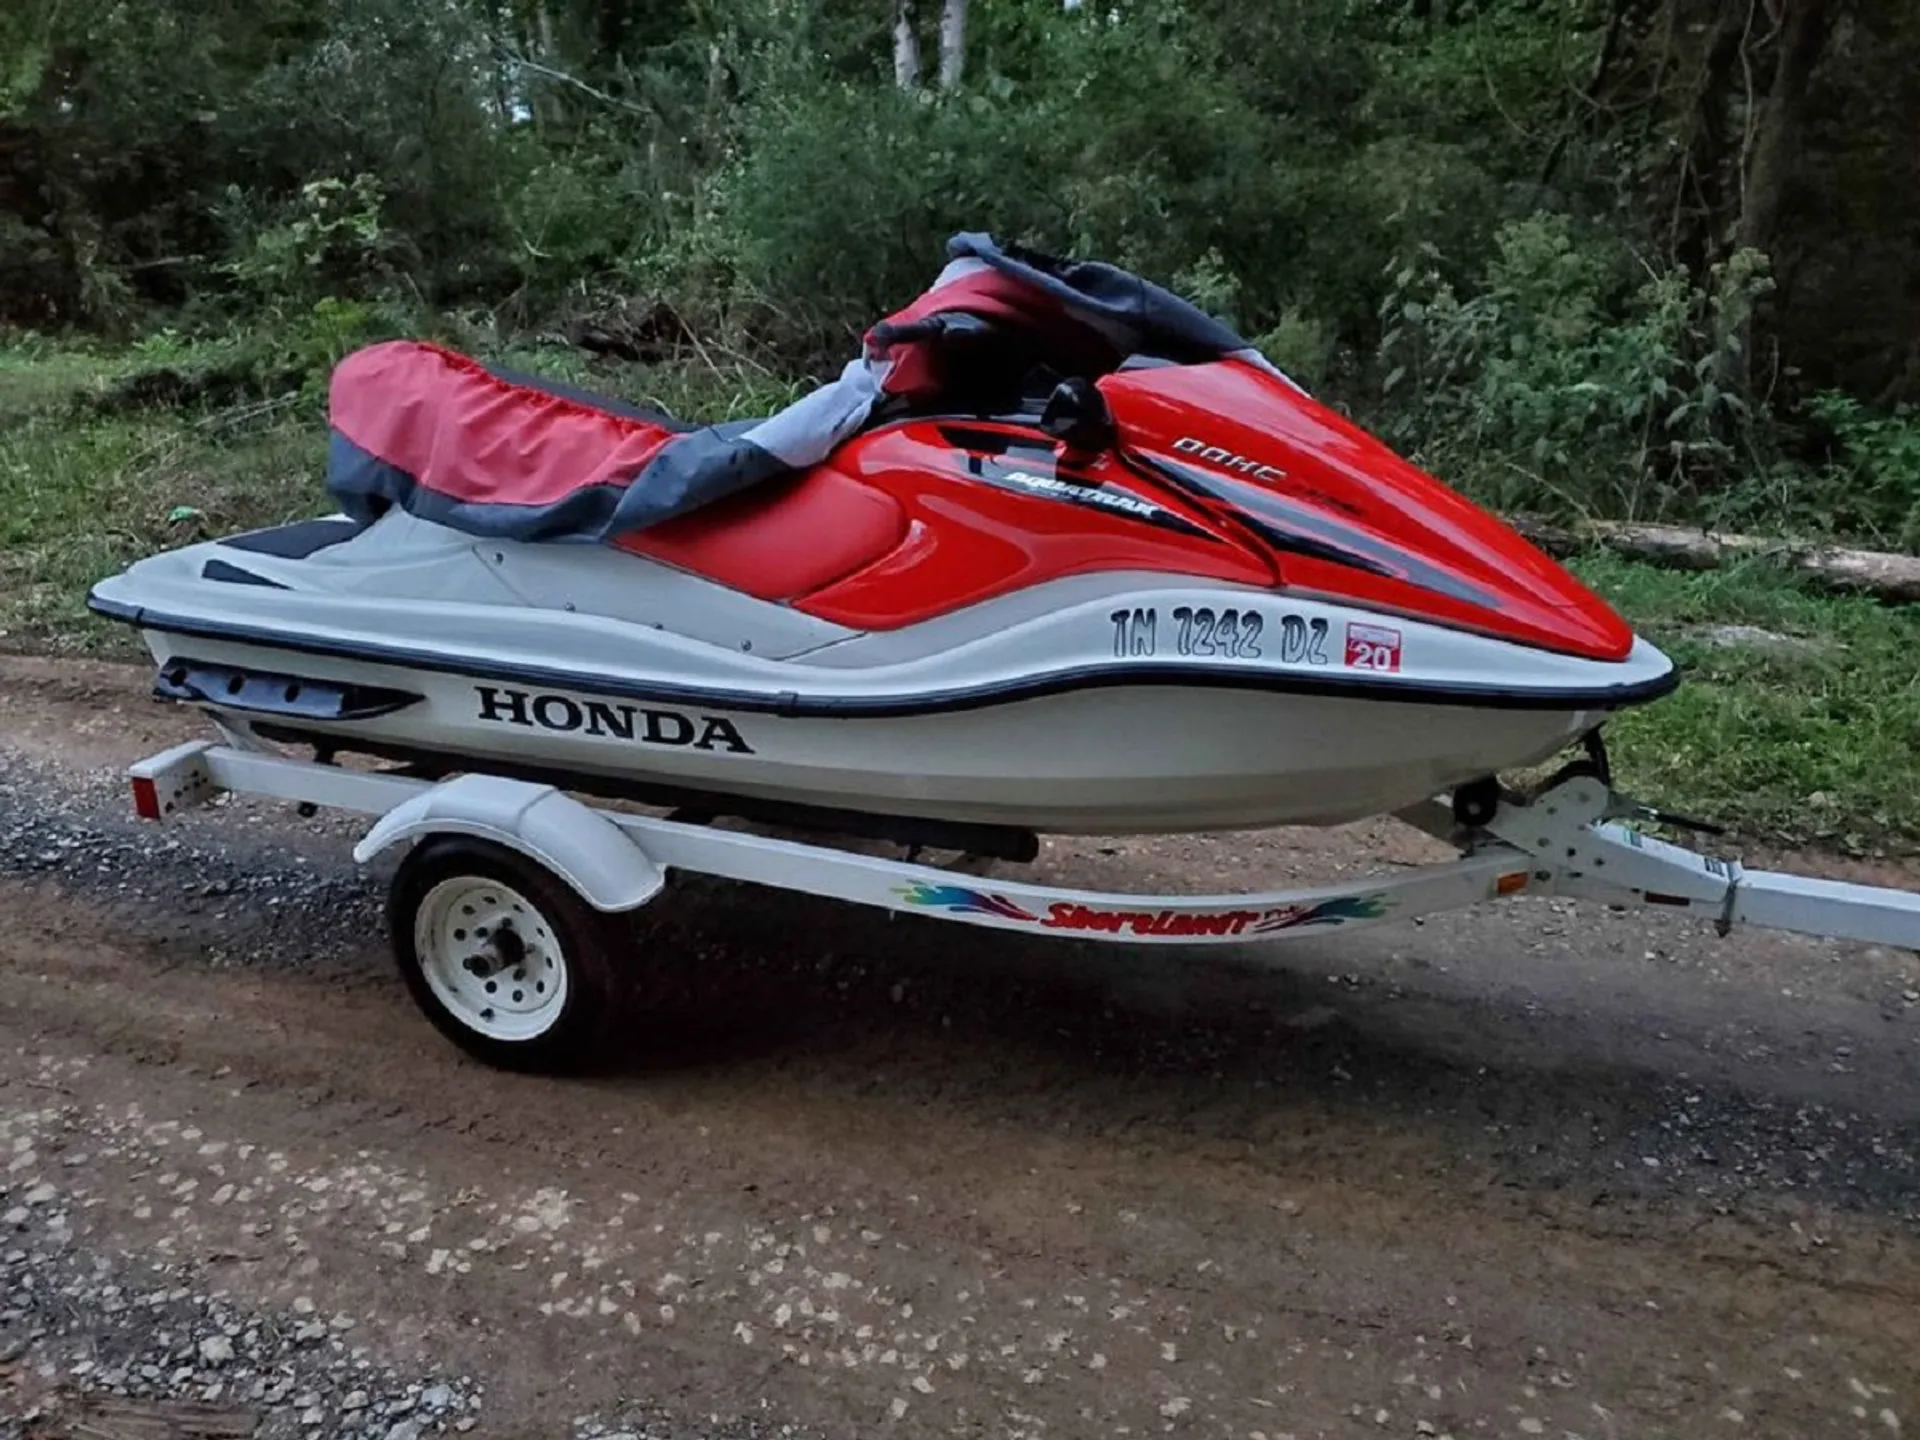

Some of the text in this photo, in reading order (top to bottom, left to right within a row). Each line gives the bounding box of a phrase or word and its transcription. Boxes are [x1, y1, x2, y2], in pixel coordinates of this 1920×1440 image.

[1171, 437, 1289, 482] DOHC
[1110, 606, 1329, 665] TN 7242 DZ
[1350, 643, 1392, 671] 20
[474, 686, 756, 754] HONDA
